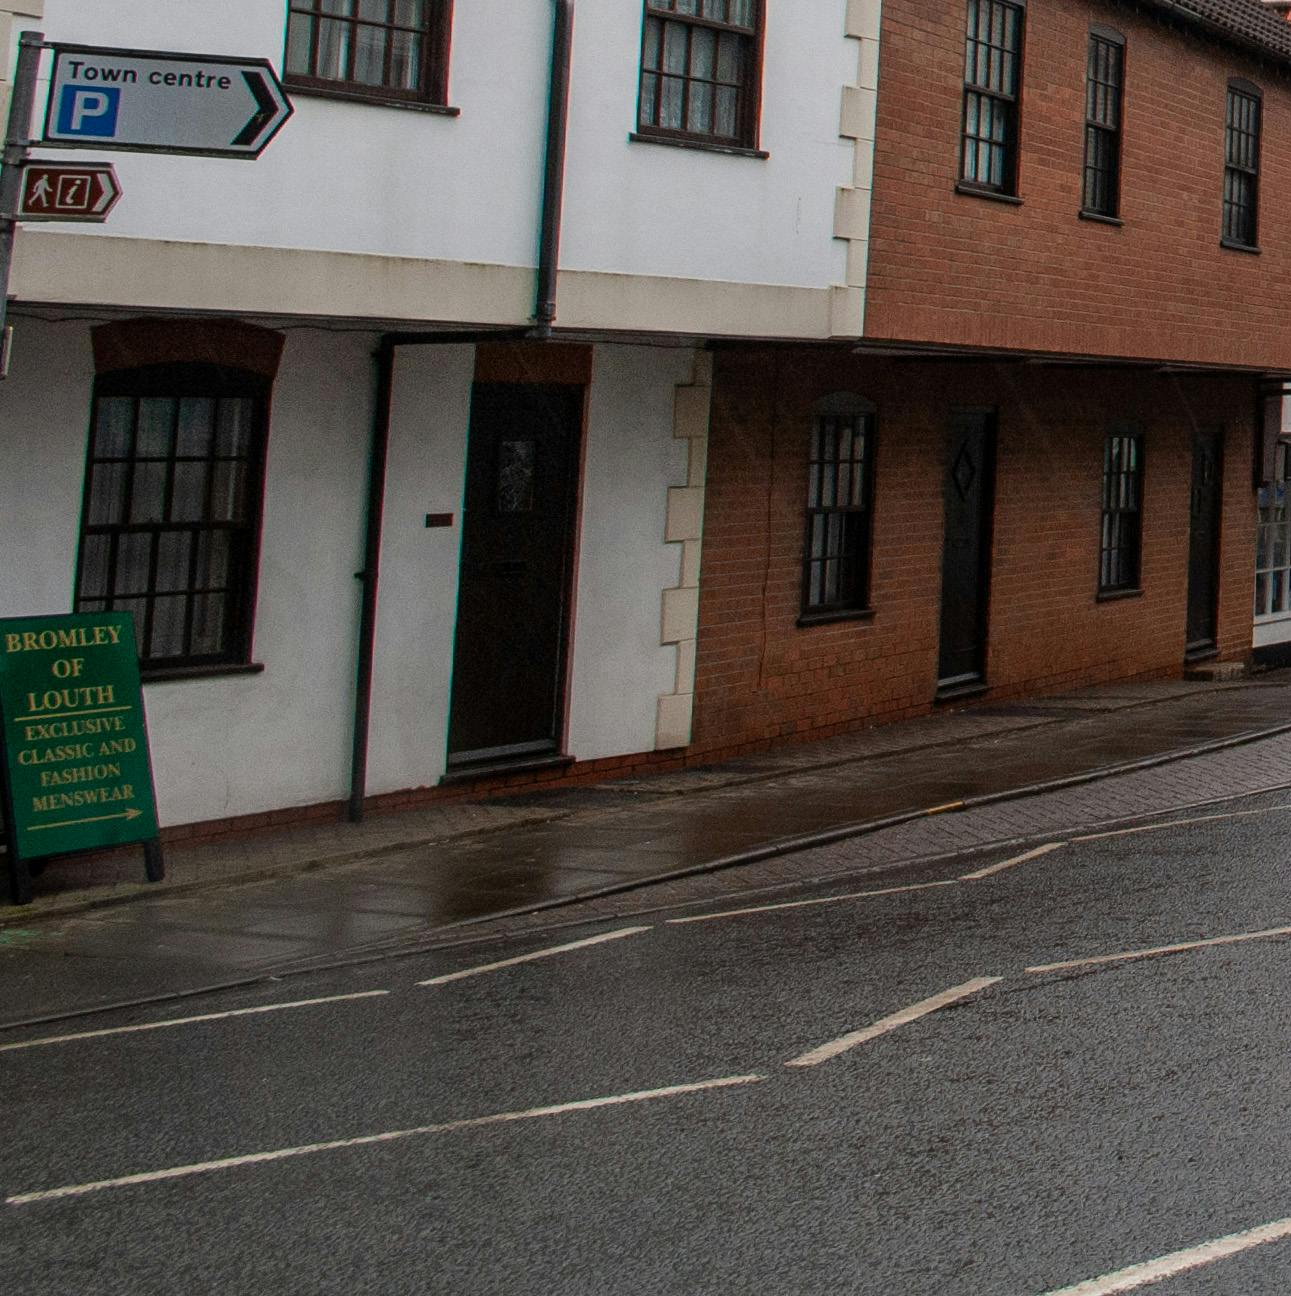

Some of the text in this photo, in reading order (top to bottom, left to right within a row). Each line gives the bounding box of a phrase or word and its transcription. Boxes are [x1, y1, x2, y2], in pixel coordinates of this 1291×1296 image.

[68, 60, 232, 90] Town centre
[70, 91, 110, 131] P
[6, 625, 122, 653] BROMLEY
[52, 658, 85, 679] OF
[27, 685, 115, 712] LOUTH
[25, 716, 126, 742] EXCLUSIVE
[17, 738, 136, 765] CLASSIC AND
[40, 762, 121, 787] FASHION
[32, 784, 135, 812] MENSWEAR
